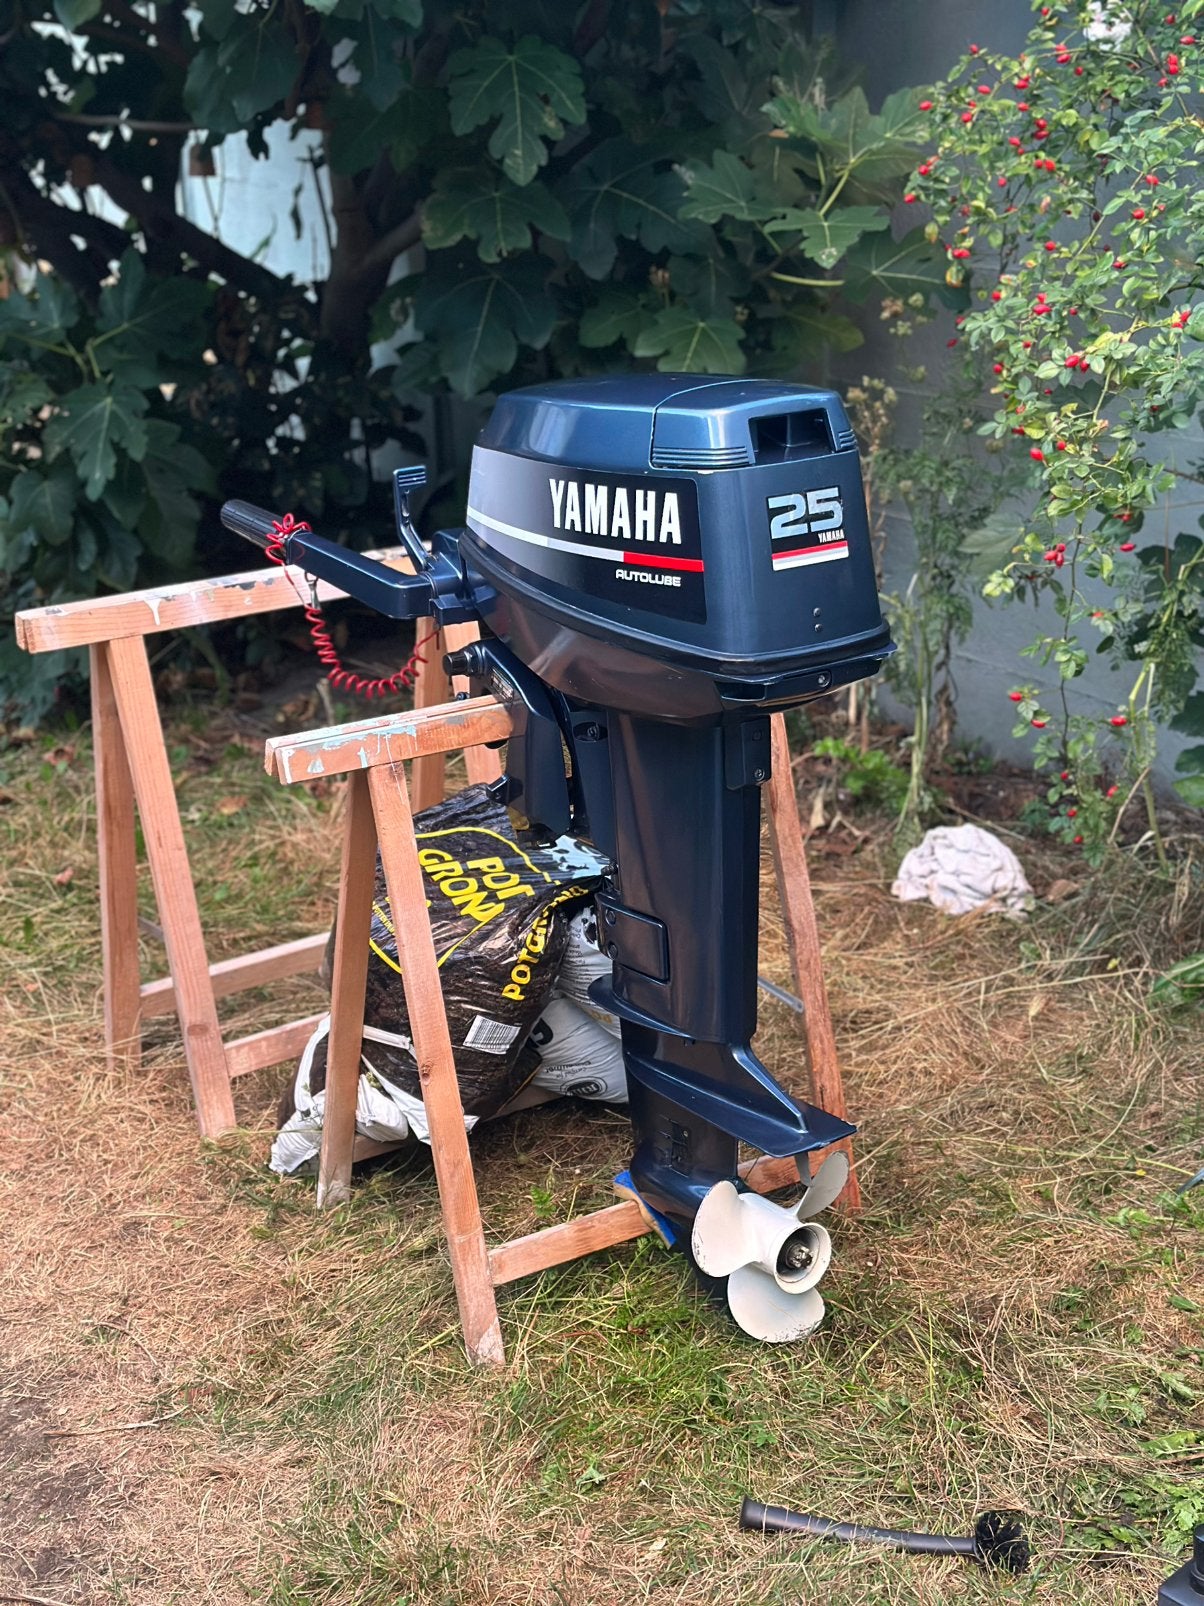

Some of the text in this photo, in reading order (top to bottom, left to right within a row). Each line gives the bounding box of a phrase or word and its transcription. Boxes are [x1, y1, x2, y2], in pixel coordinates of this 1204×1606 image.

[549, 478, 682, 545] YAMAHA
[768, 487, 843, 539] 25
[817, 529, 845, 543] YAMAHA
[615, 569, 682, 587] AUTOLUBE
